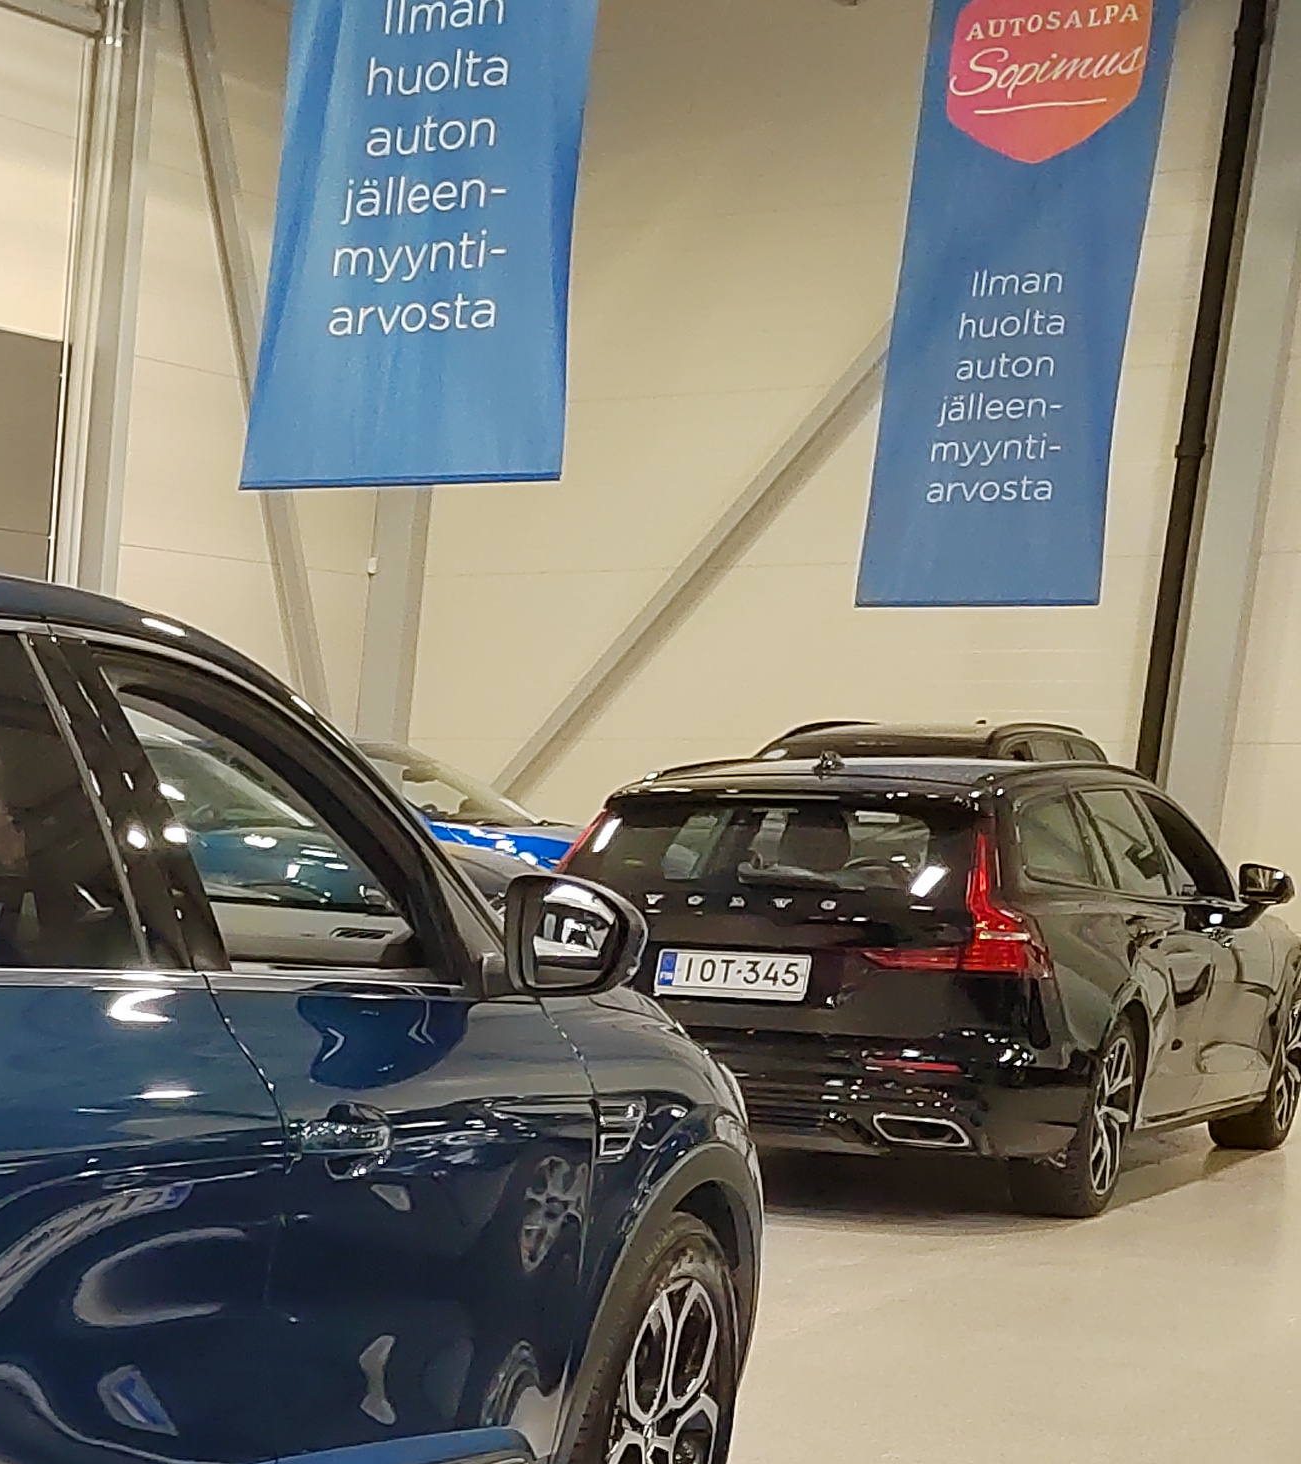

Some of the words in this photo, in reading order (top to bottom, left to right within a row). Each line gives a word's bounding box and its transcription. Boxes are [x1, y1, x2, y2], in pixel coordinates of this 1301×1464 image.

[384, 0, 505, 34] Ilman
[965, 3, 1140, 42] AUTOSALPA
[366, 49, 510, 97] huolta
[948, 45, 1144, 99] Sopimus
[365, 115, 496, 158] auton
[339, 176, 508, 226] jälleen-
[332, 228, 508, 284] myynti-
[970, 268, 1064, 298] Ilman
[327, 292, 497, 337] arvosta
[958, 307, 1066, 341] huolta
[955, 352, 1055, 381] auton
[936, 391, 1065, 428] jälleen-
[930, 432, 1062, 467] myynti-
[925, 474, 1054, 504] arvosta
[684, 957, 800, 987] IOT-345
